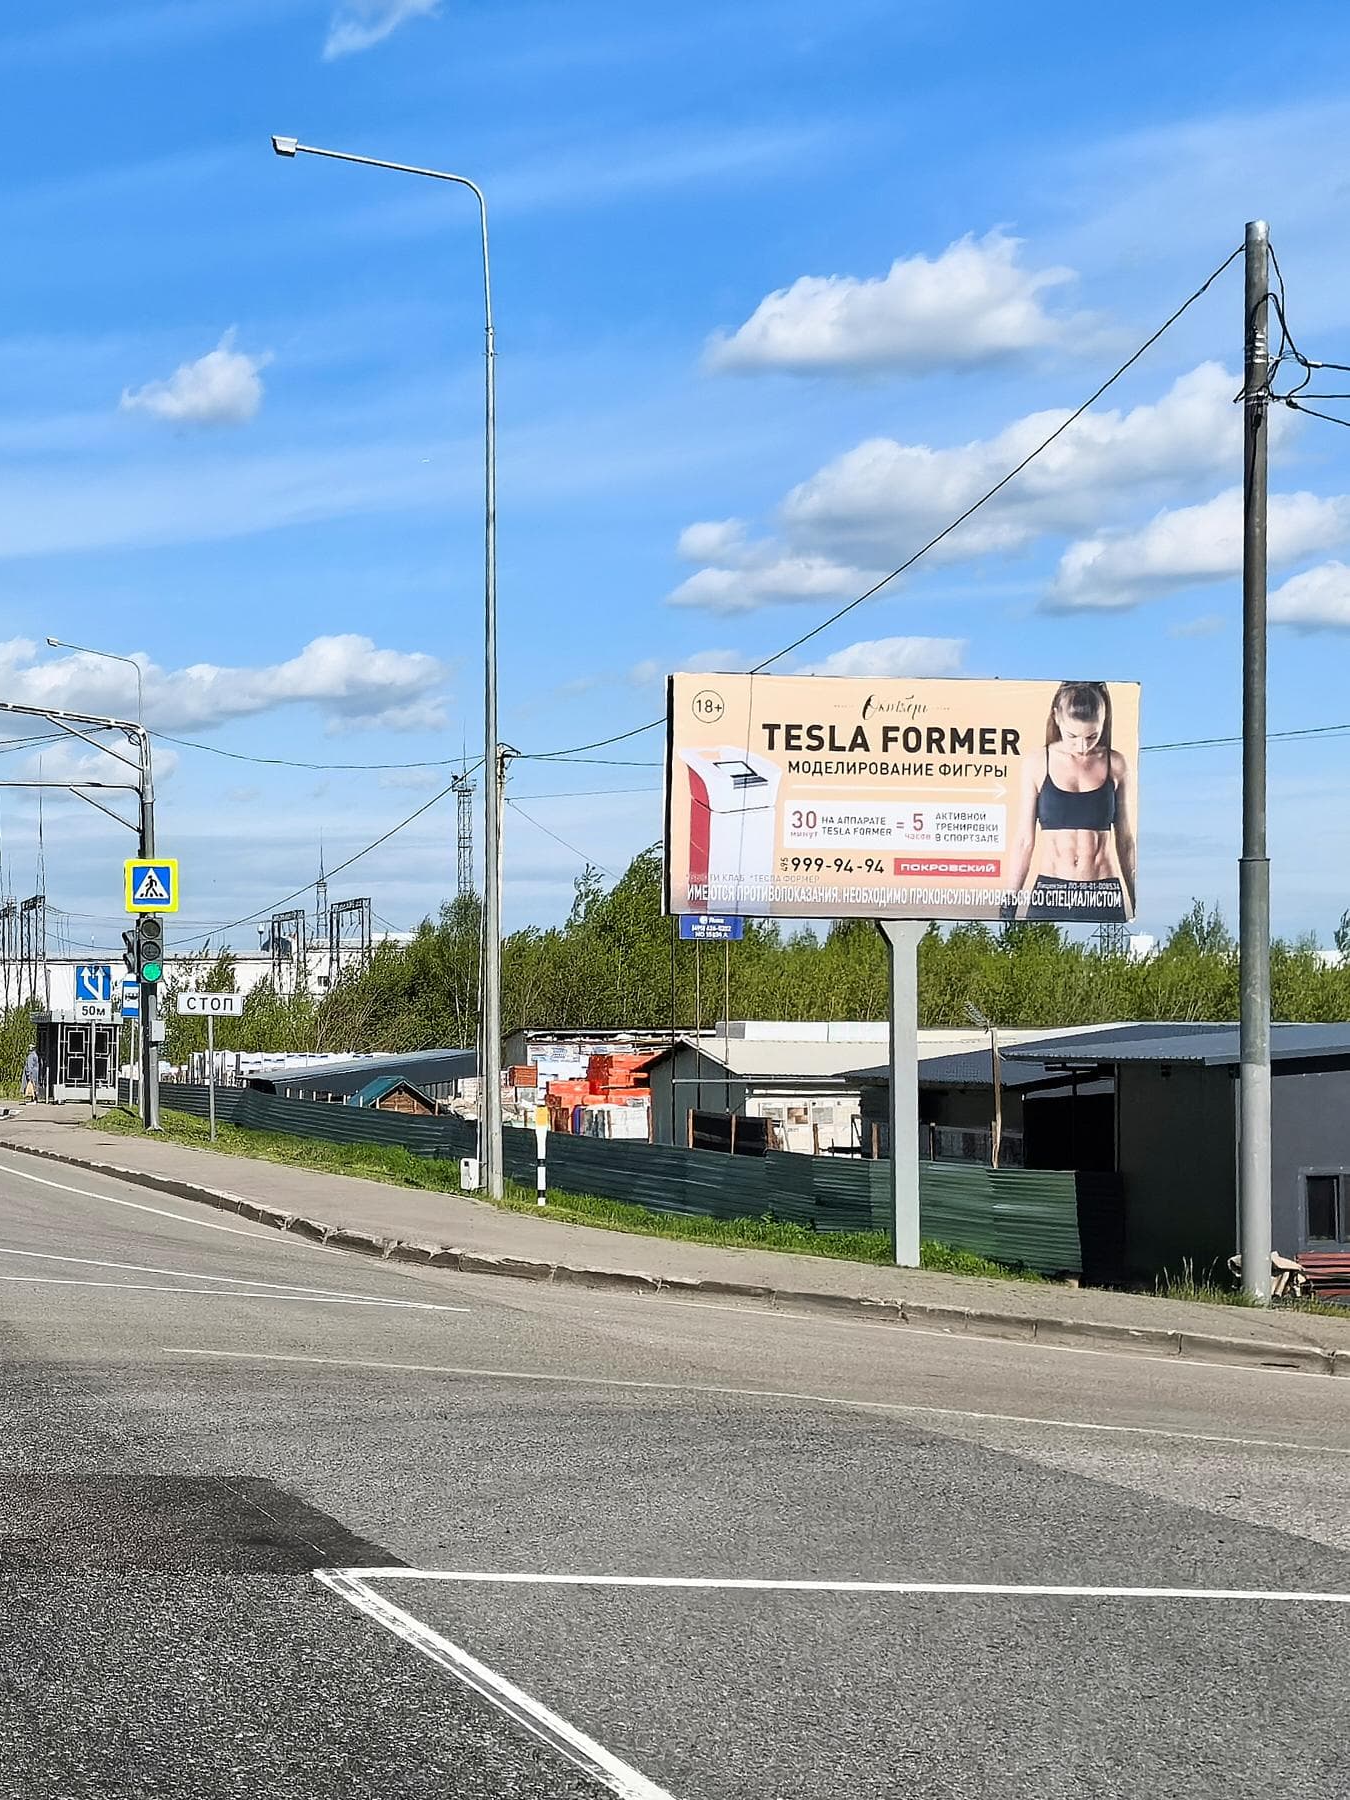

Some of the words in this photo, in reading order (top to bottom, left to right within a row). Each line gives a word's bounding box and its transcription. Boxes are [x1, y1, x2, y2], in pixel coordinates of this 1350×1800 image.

[695, 699, 723, 713] 18+
[761, 723, 871, 753] TESLA
[881, 725, 1021, 756] FORMER
[788, 760, 934, 777] МОДЕЛИРОВАНИЕ
[938, 763, 1008, 778] ФИГУРЫ
[791, 810, 818, 829] 30
[821, 816, 835, 825] НА
[837, 816, 887, 826] АППАРАТЕ
[912, 812, 924, 832] 5
[935, 811, 987, 821] АКТИВНОЙ
[821, 826, 851, 836] TESLA
[853, 827, 892, 837] FORMER
[935, 822, 999, 832] ТРЕНИРОВКИ
[935, 833, 942, 842] В
[943, 833, 1000, 843] СПОРТЗАЛЕ
[791, 856, 885, 874] 999-94-94
[900, 863, 997, 873] ПОКРОВСКИЙ
[842, 887, 908, 907] НЕОБХОДИМО
[909, 888, 1030, 908] ПРОКОНСУЛЬТИРОВАТЬСЯ
[1031, 889, 1045, 906] СО
[1045, 889, 1122, 910] СПЕЦИАЛИСТОМ
[186, 996, 234, 1011] СТОП
